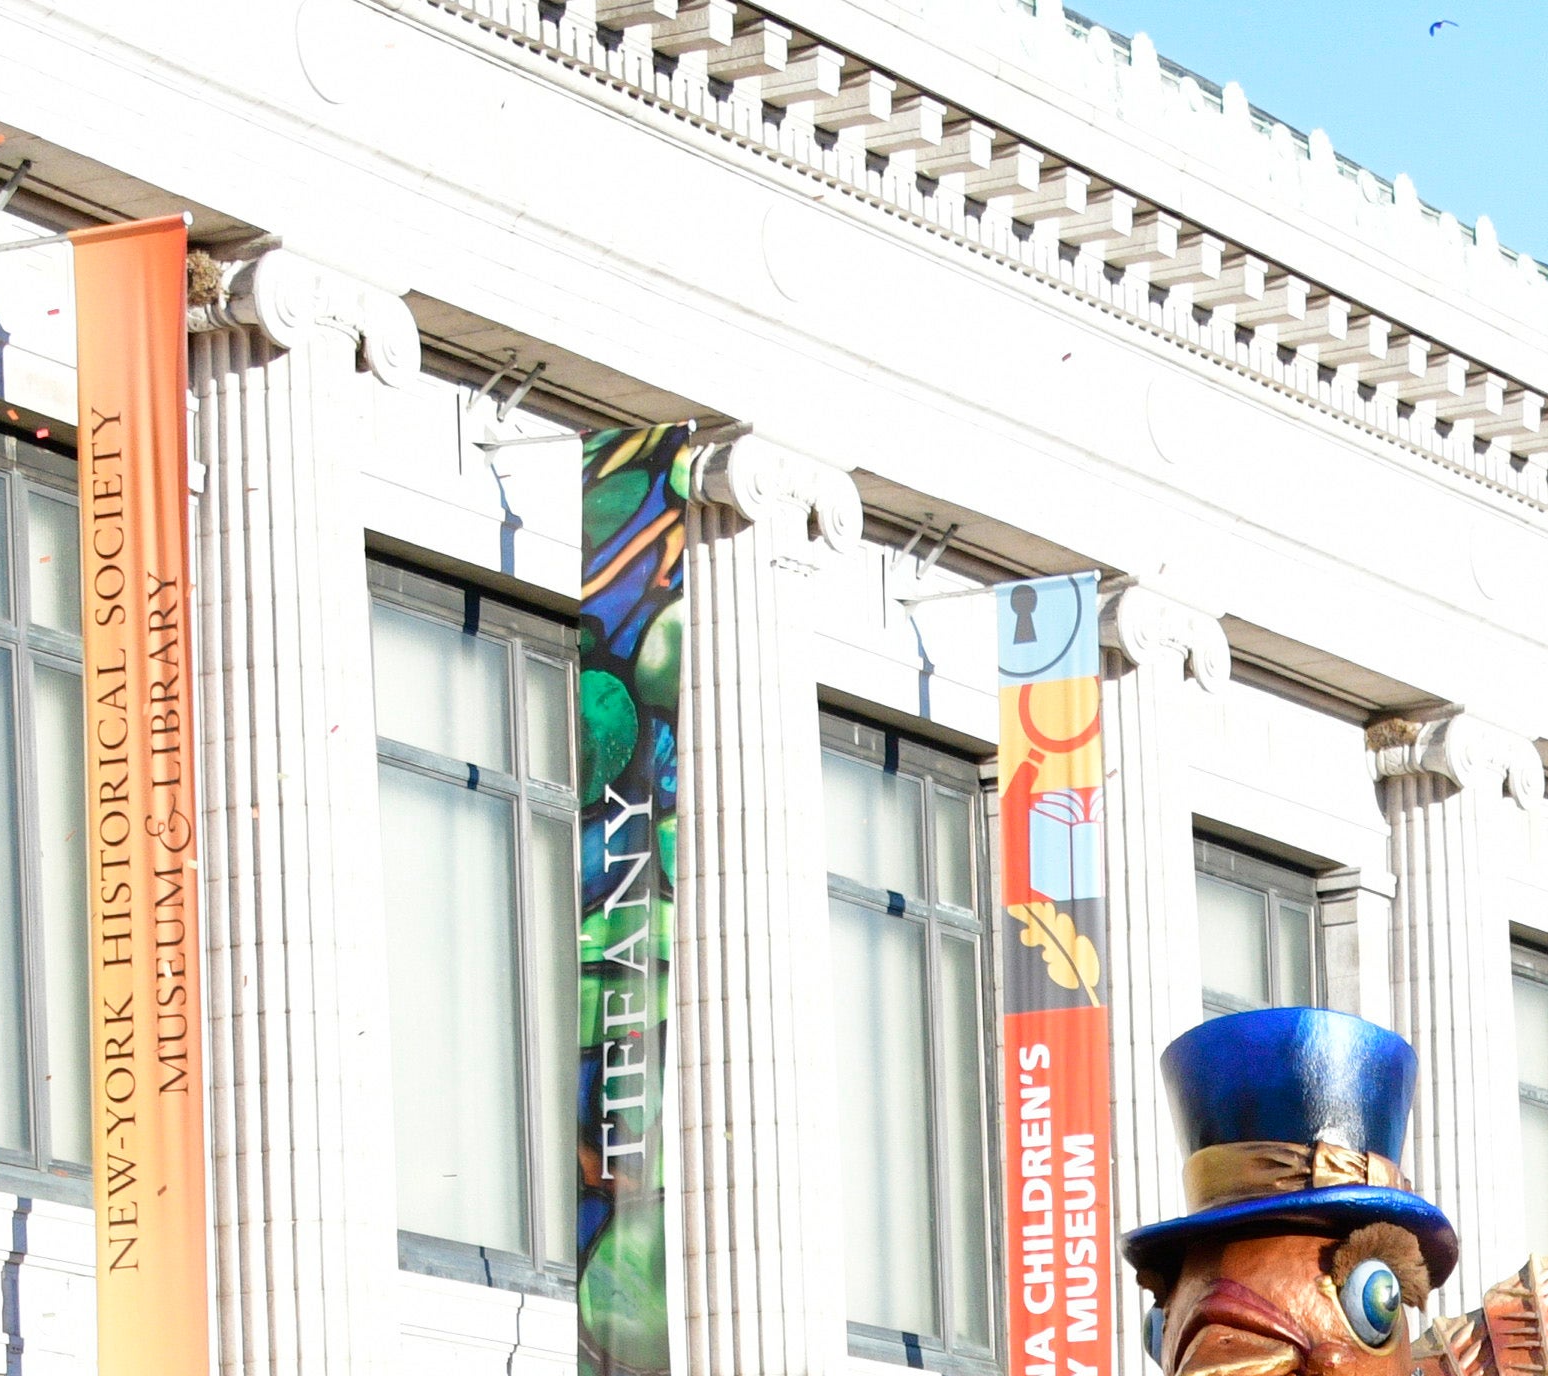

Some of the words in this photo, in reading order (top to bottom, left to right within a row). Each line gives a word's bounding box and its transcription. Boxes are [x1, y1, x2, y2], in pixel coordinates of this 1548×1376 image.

[91, 406, 126, 626] SOCIETY
[147, 571, 181, 791] LIBRARY
[97, 647, 133, 971] HISTORICAL
[144, 794, 191, 853] &
[154, 862, 189, 1097] MUSEUM
[601, 783, 653, 1180] TIFFANY
[104, 992, 139, 1275] NEW-YORK
[1019, 1041, 1055, 1315] CHILDREN'S
[1063, 1132, 1098, 1344] MUSEUM
